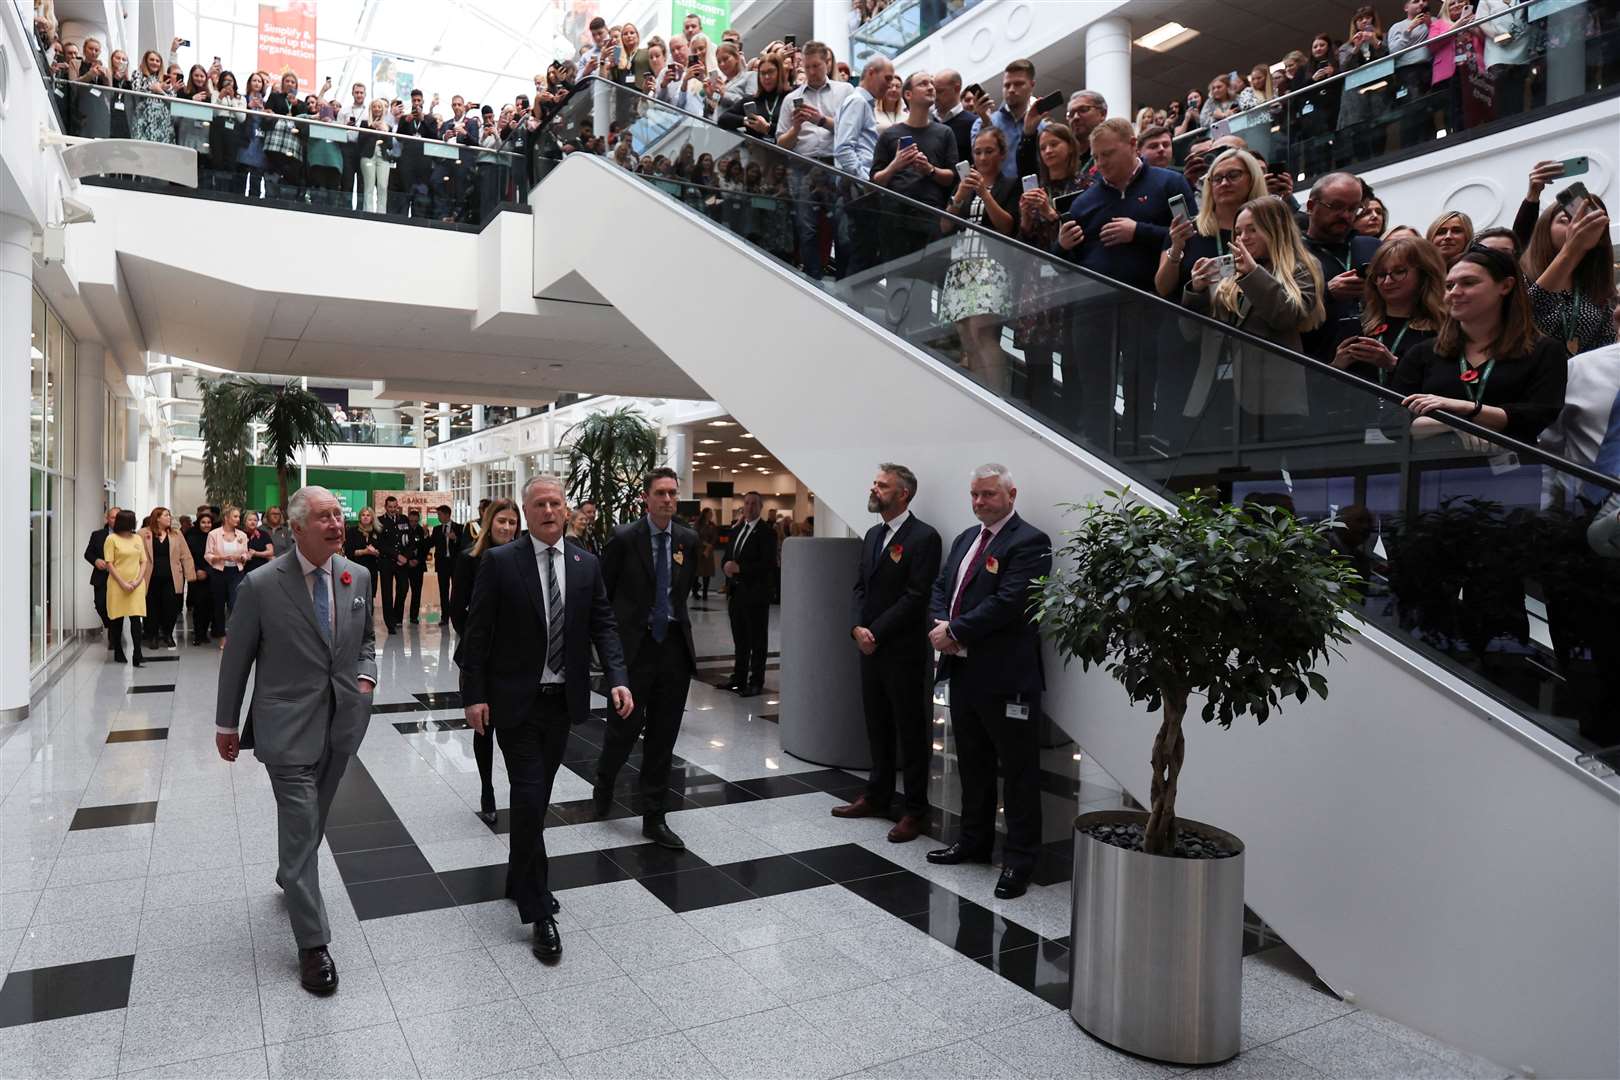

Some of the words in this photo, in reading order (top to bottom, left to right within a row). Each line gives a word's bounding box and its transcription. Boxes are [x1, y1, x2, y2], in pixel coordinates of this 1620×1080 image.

[264, 23, 302, 40] Simplify
[303, 30, 311, 39] &
[259, 34, 286, 45] speed
[287, 39, 299, 48] up
[301, 39, 315, 50] the
[259, 43, 315, 59] organisation
